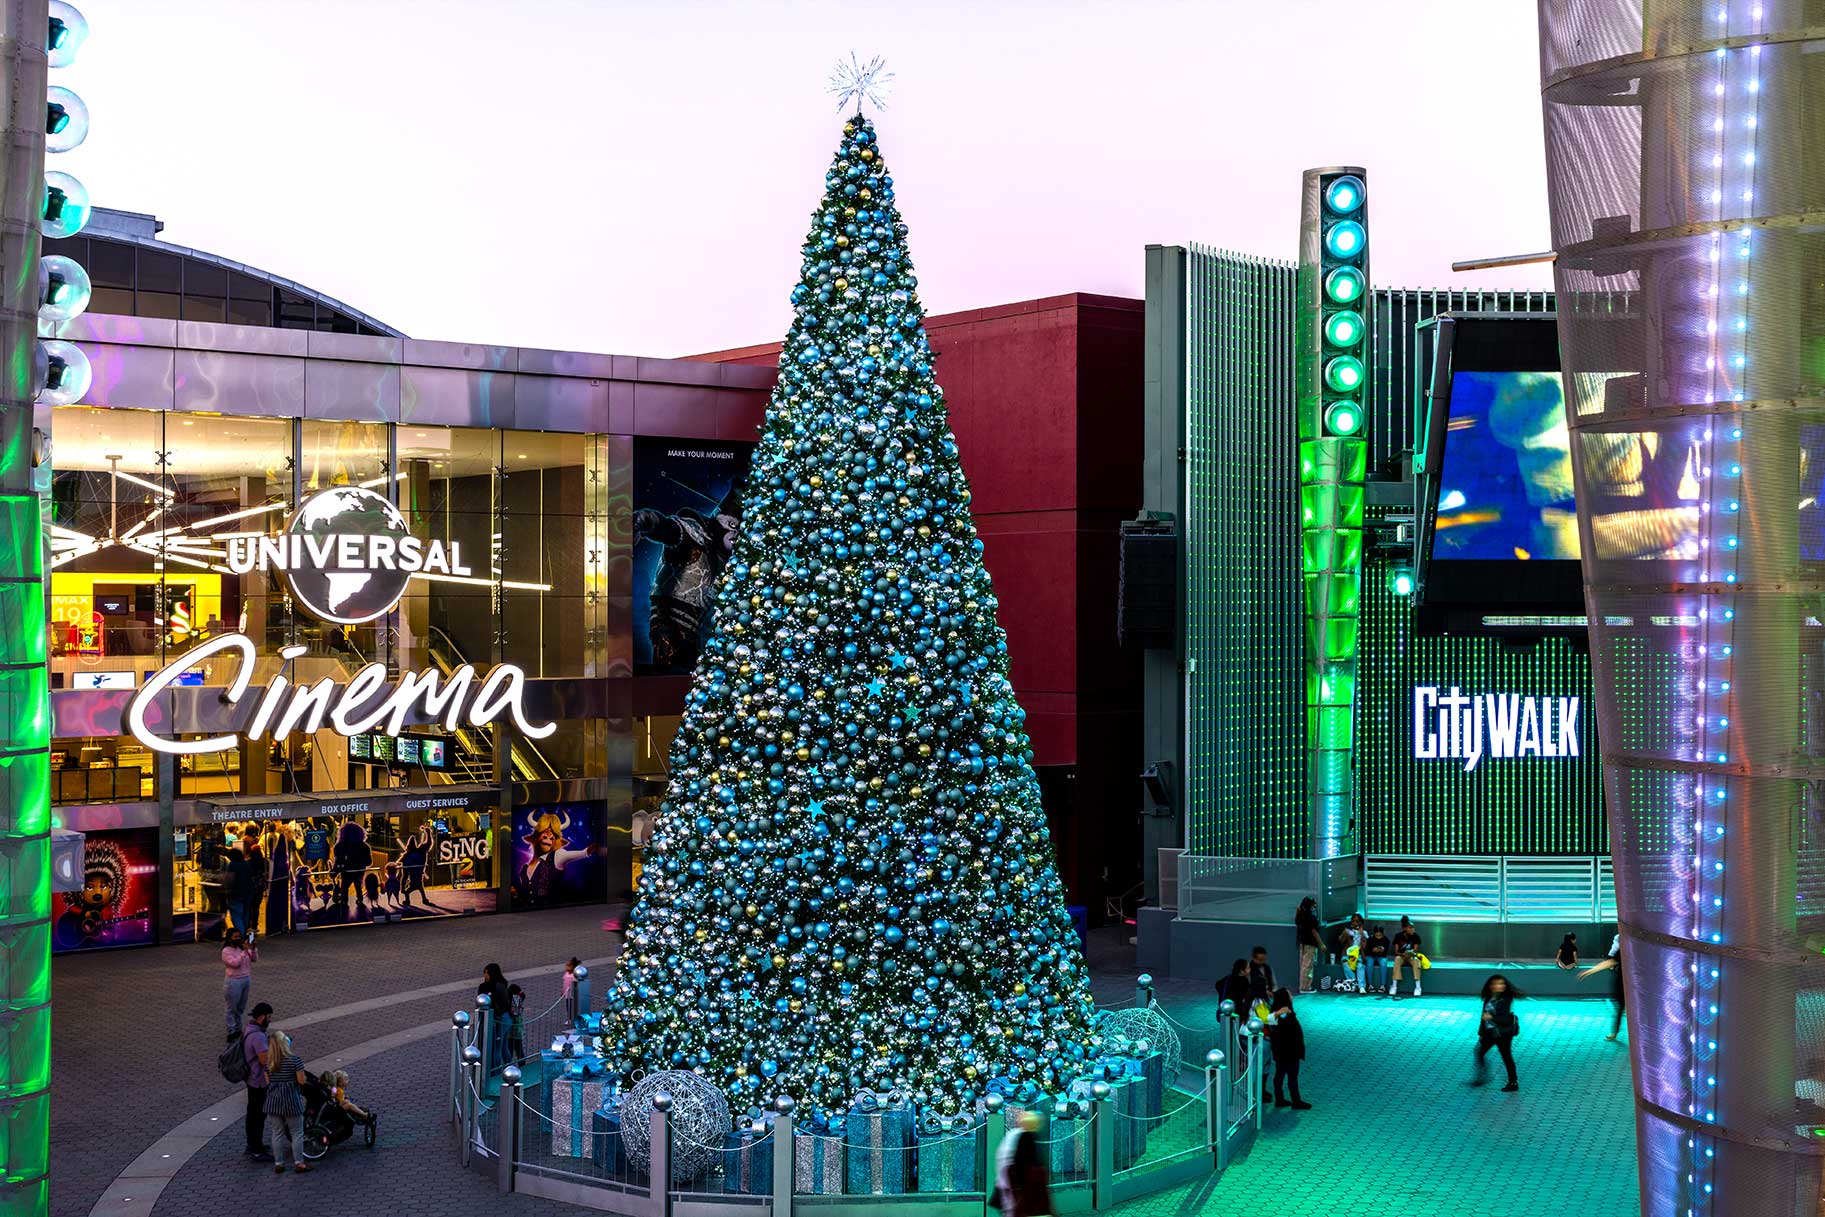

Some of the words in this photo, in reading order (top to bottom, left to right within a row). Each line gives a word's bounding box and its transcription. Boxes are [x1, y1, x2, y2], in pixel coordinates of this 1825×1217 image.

[228, 533, 471, 576] UNIVERSAL
[128, 632, 557, 755] Cinema
[321, 805, 339, 814] BOX
[340, 803, 369, 813] OFFICE
[406, 799, 431, 809] GUEST
[432, 797, 469, 807] SERVICES
[212, 809, 252, 820] THEATRE
[255, 808, 283, 818] ENTRY
[460, 857, 474, 876] 2
